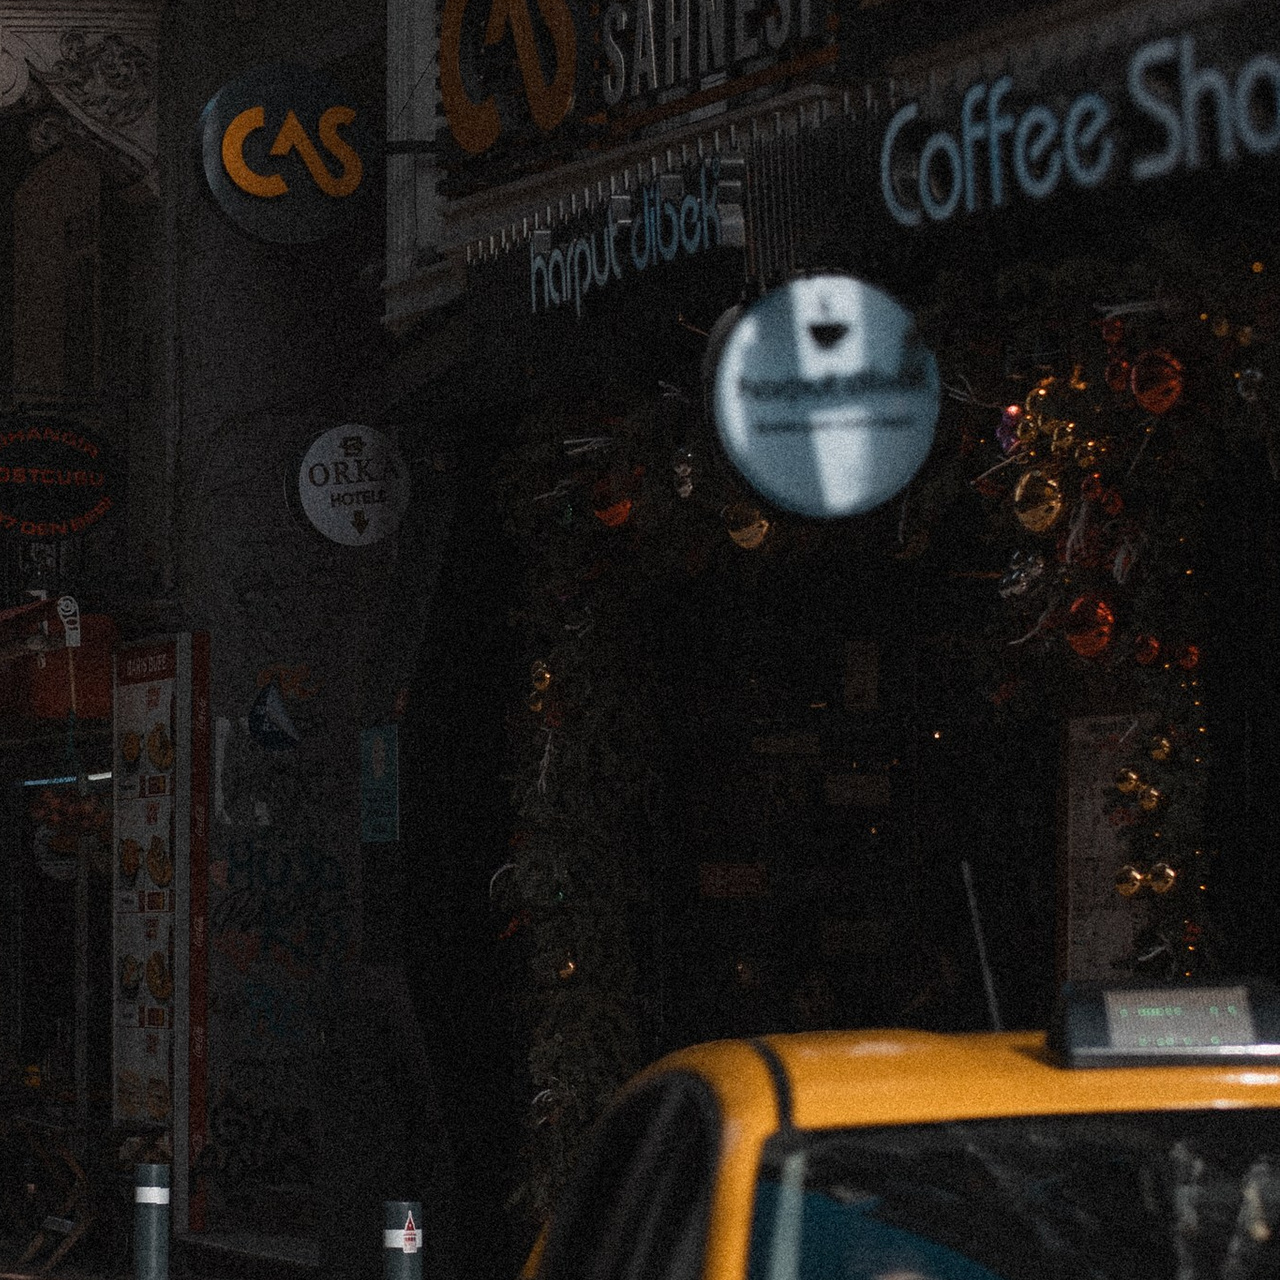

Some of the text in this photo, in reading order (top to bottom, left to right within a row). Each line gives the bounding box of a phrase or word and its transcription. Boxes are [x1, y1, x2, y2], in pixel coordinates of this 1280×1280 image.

[222, 105, 364, 198] CAS
[880, 75, 1114, 227] Coffee
[530, 208, 623, 319] harput
[309, 458, 399, 487] ORKA
